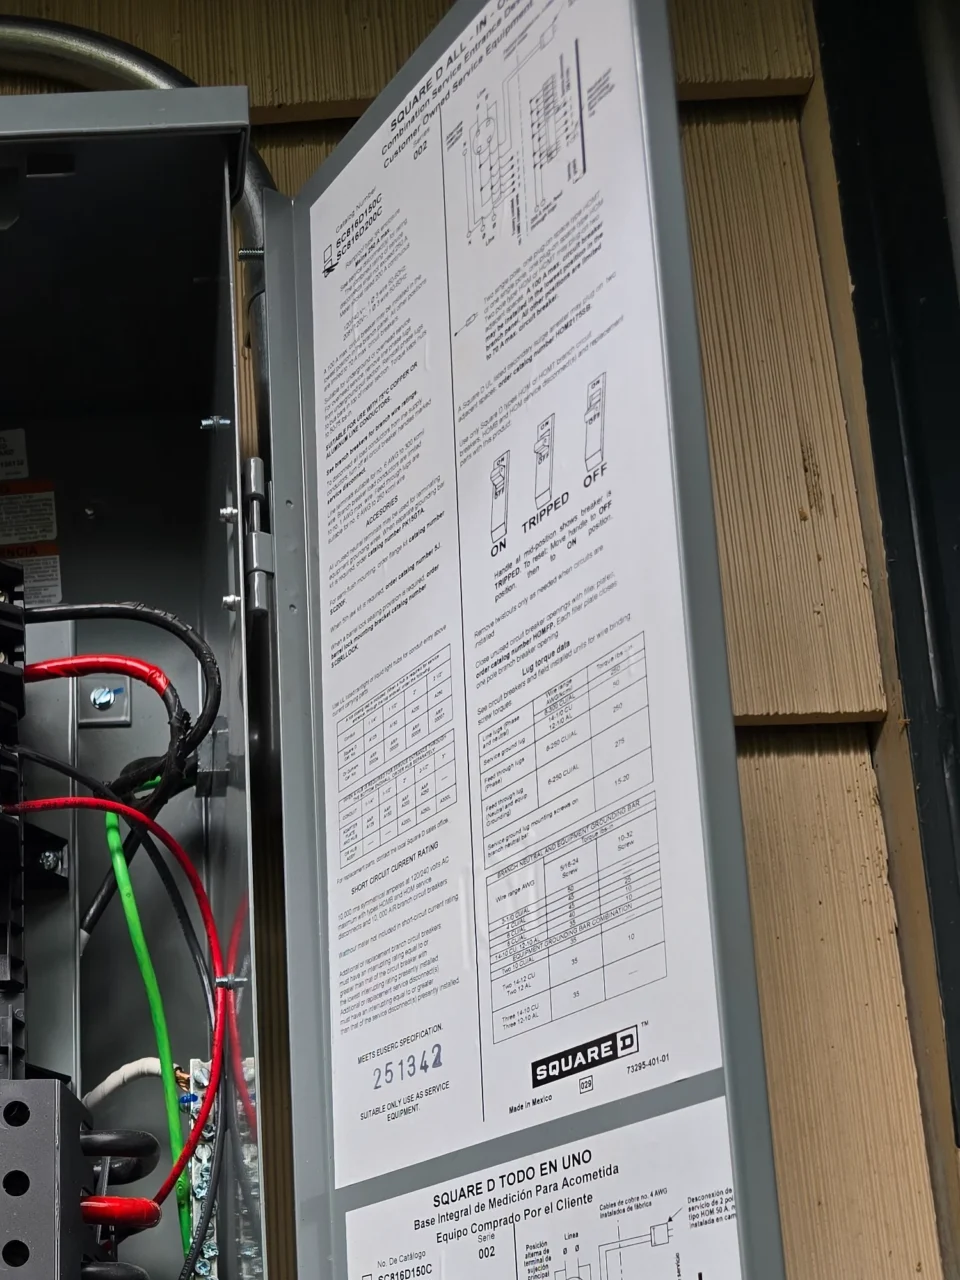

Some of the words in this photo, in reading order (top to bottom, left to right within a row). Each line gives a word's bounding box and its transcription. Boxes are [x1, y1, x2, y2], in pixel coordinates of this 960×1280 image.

[382, 99, 430, 155] Combination
[432, 64, 462, 99] Service
[464, 19, 501, 64] Entrance
[384, 125, 421, 168] Customer
[423, 90, 450, 126] Owned
[453, 56, 483, 93] Service
[486, 0, 533, 57] Equipment
[391, 77, 432, 131] SQUARE
[436, 66, 443, 79] D
[446, 42, 466, 68] ALL
[476, 15, 487, 35] IN
[414, 141, 427, 160] 002
[336, 193, 382, 248] SC816D150C
[337, 206, 382, 260] SC816D200C
[584, 462, 607, 488] OFF
[522, 492, 569, 534] TRIPPED
[491, 539, 506, 557] ON
[522, 663, 534, 676] Lug
[535, 649, 555, 668] torque
[557, 639, 570, 653] data
[351, 880, 368, 895] SHORT
[369, 868, 390, 884] CIRCUIT
[391, 853, 417, 873] CURRENT
[417, 841, 438, 856] RATING
[358, 1051, 375, 1064] MEETS
[377, 1042, 398, 1056] EUSERC
[400, 1023, 443, 1047] SPECIFICATION.
[536, 1040, 613, 1081] SQUARE
[620, 1033, 634, 1049] D
[627, 1053, 670, 1074] 73295-401-01
[373, 1043, 442, 1089] 251342
[581, 1080, 591, 1089] 029
[360, 1105, 386, 1120] SUITABLE
[387, 1099, 402, 1111] ONLY
[403, 1094, 414, 1104] USE
[416, 1091, 424, 1099] AS
[425, 1081, 450, 1096] SERVICE
[387, 1104, 420, 1121] EQUIPMENT.
[509, 1103, 523, 1114] Made
[525, 1100, 530, 1108] in
[532, 1094, 552, 1106] Mexico
[414, 1216, 436, 1230] Base
[438, 1204, 472, 1224] Integral
[474, 1202, 486, 1213] de
[489, 1190, 533, 1210] Medición
[536, 1183, 559, 1197] Para
[562, 1163, 619, 1189] Acometida
[433, 1182, 483, 1208] SQUARE
[487, 1178, 495, 1192] D
[499, 1166, 535, 1188] TODO
[540, 1159, 558, 1176] EN
[562, 1149, 592, 1170] UNO
[437, 1228, 468, 1244] Equipo
[471, 1213, 521, 1234] Comprado
[524, 1208, 541, 1221] Por
[545, 1202, 553, 1214] el
[556, 1193, 593, 1211] Cliente
[478, 1232, 495, 1243] Serie
[377, 1260, 387, 1268] No.
[389, 1256, 397, 1264] De
[399, 1250, 426, 1264] Catálogo
[479, 1246, 495, 1259] 002
